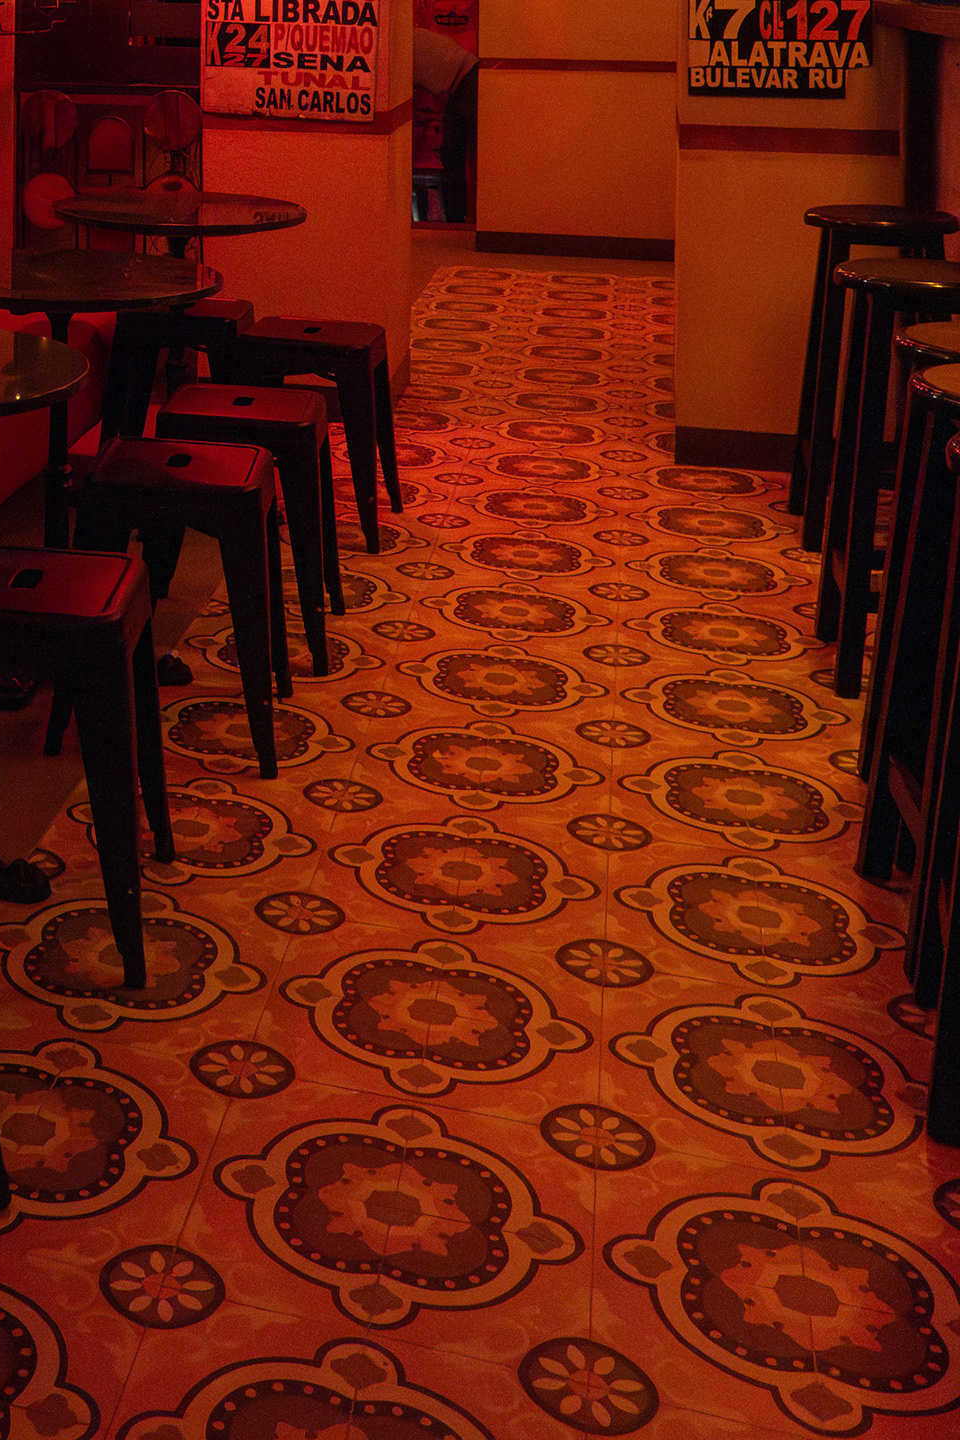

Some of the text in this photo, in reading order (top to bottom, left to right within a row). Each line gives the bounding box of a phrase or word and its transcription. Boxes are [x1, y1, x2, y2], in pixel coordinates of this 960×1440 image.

[714, 0, 756, 39] 7
[786, 0, 870, 40] 127
[224, 24, 271, 54] 24
[272, 52, 371, 73] SENA
[708, 41, 869, 68] ALATRAVA
[257, 71, 371, 91] TUNAL
[690, 68, 844, 89] BULEVAR RU
[298, 89, 371, 114] CARLOS
